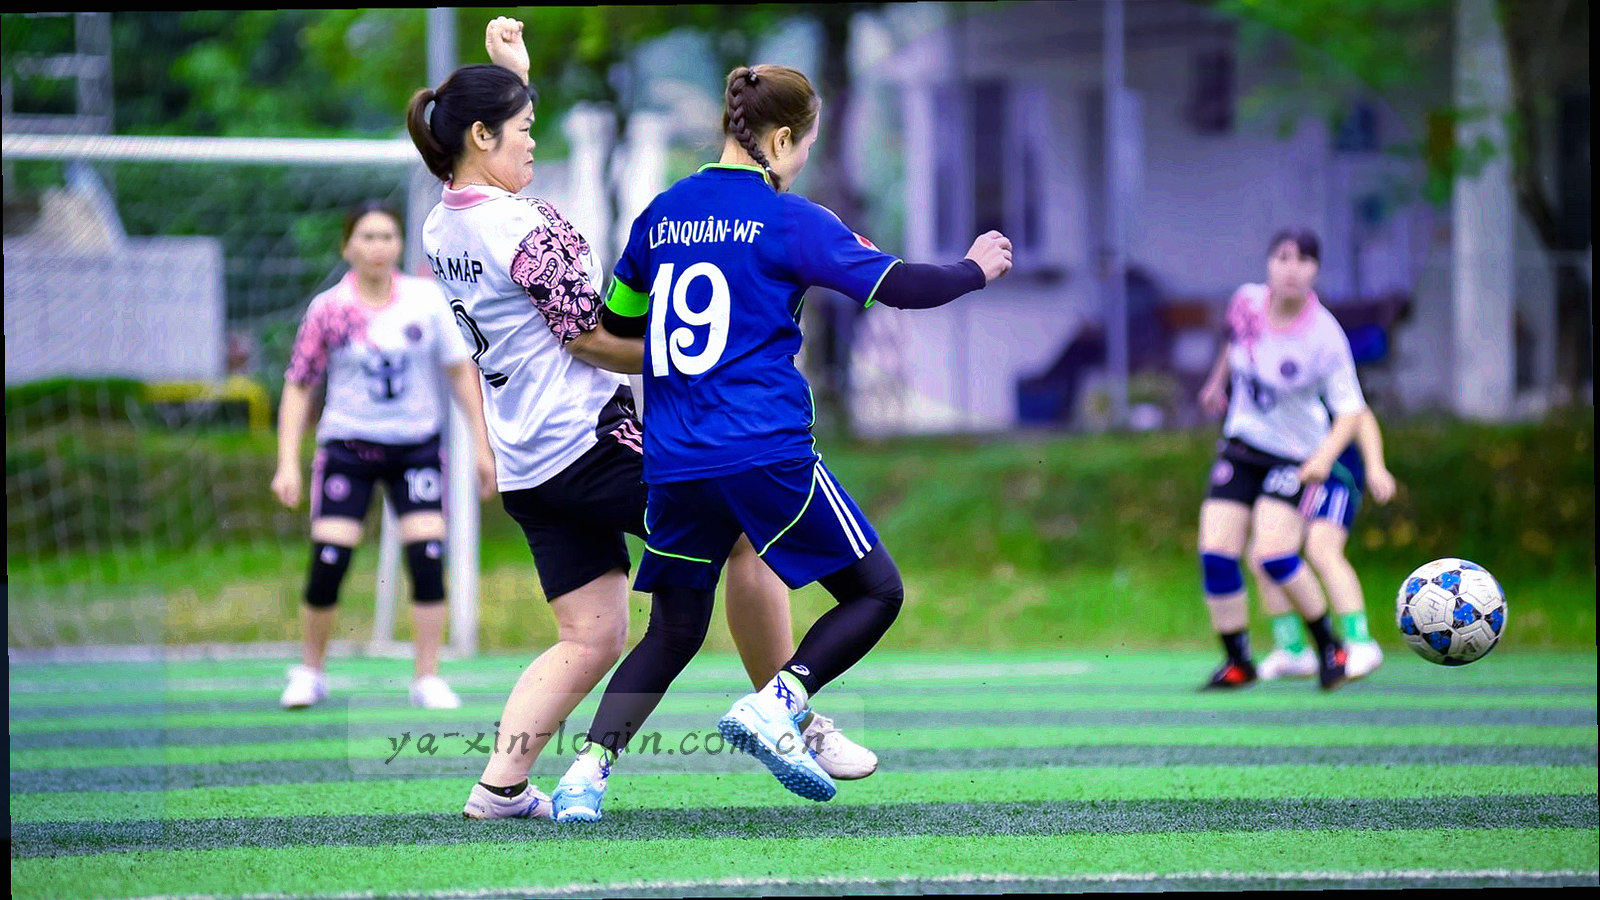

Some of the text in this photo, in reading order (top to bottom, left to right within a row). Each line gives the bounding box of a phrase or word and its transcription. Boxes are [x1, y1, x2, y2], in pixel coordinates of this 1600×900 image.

[649, 216, 764, 249] LIÊNQUÂN-WF
[447, 250, 483, 289] MẬP
[649, 262, 731, 377] 19
[404, 468, 441, 502] 10
